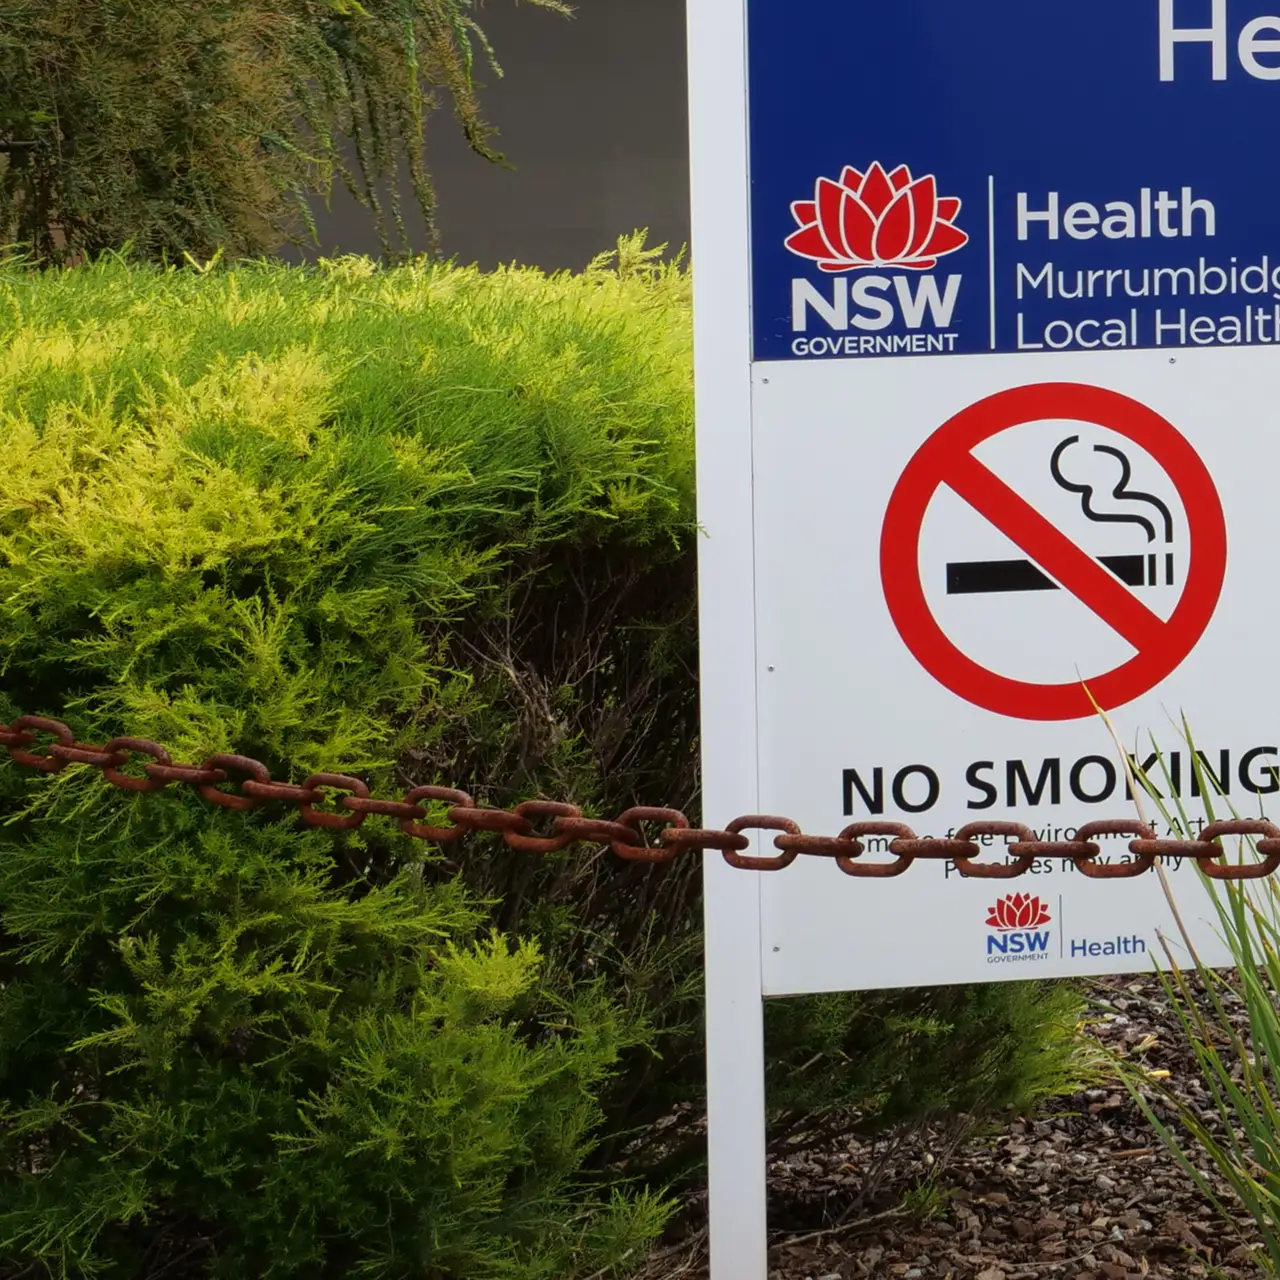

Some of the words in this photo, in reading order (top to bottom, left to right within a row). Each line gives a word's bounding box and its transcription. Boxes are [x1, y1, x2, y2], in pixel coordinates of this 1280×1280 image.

[1016, 187, 1216, 240] Health
[791, 275, 962, 332] NSW
[791, 334, 959, 357] GOVERNMENT
[1017, 308, 1138, 351] Local
[843, 765, 940, 816] NO
[966, 746, 1280, 811] SMOKING
[987, 931, 1050, 954] NSW
[987, 953, 1049, 963] GOVERNMENT
[1070, 935, 1146, 958] Health
